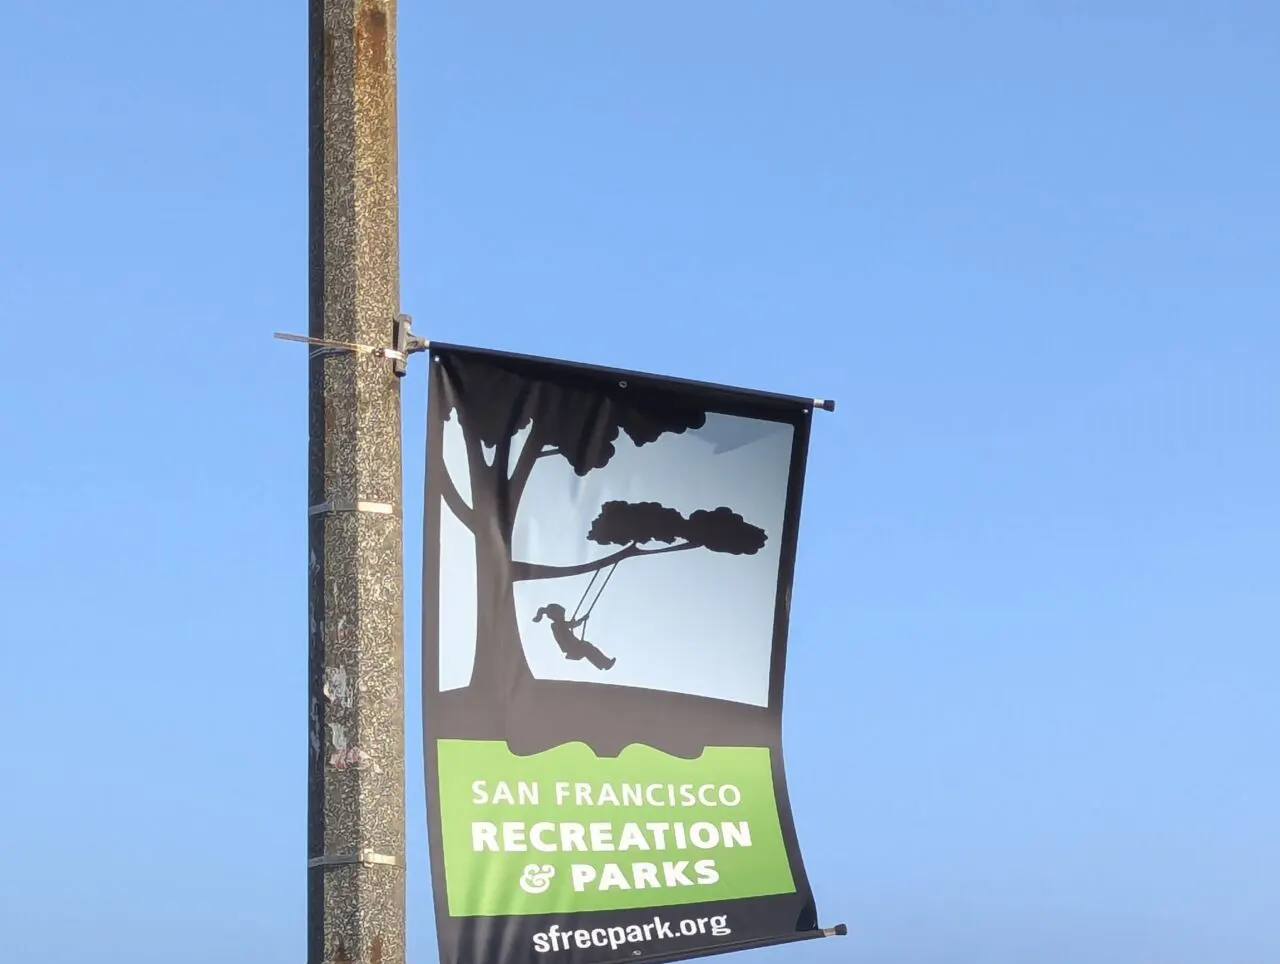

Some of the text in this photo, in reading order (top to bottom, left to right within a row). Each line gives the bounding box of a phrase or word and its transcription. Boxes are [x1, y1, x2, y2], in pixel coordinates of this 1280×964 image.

[471, 780, 741, 807] SAN FRANCISCO
[472, 821, 752, 852] RECREATION
[520, 860, 719, 893] & PARKS
[532, 914, 731, 953] sfrecpark.org
